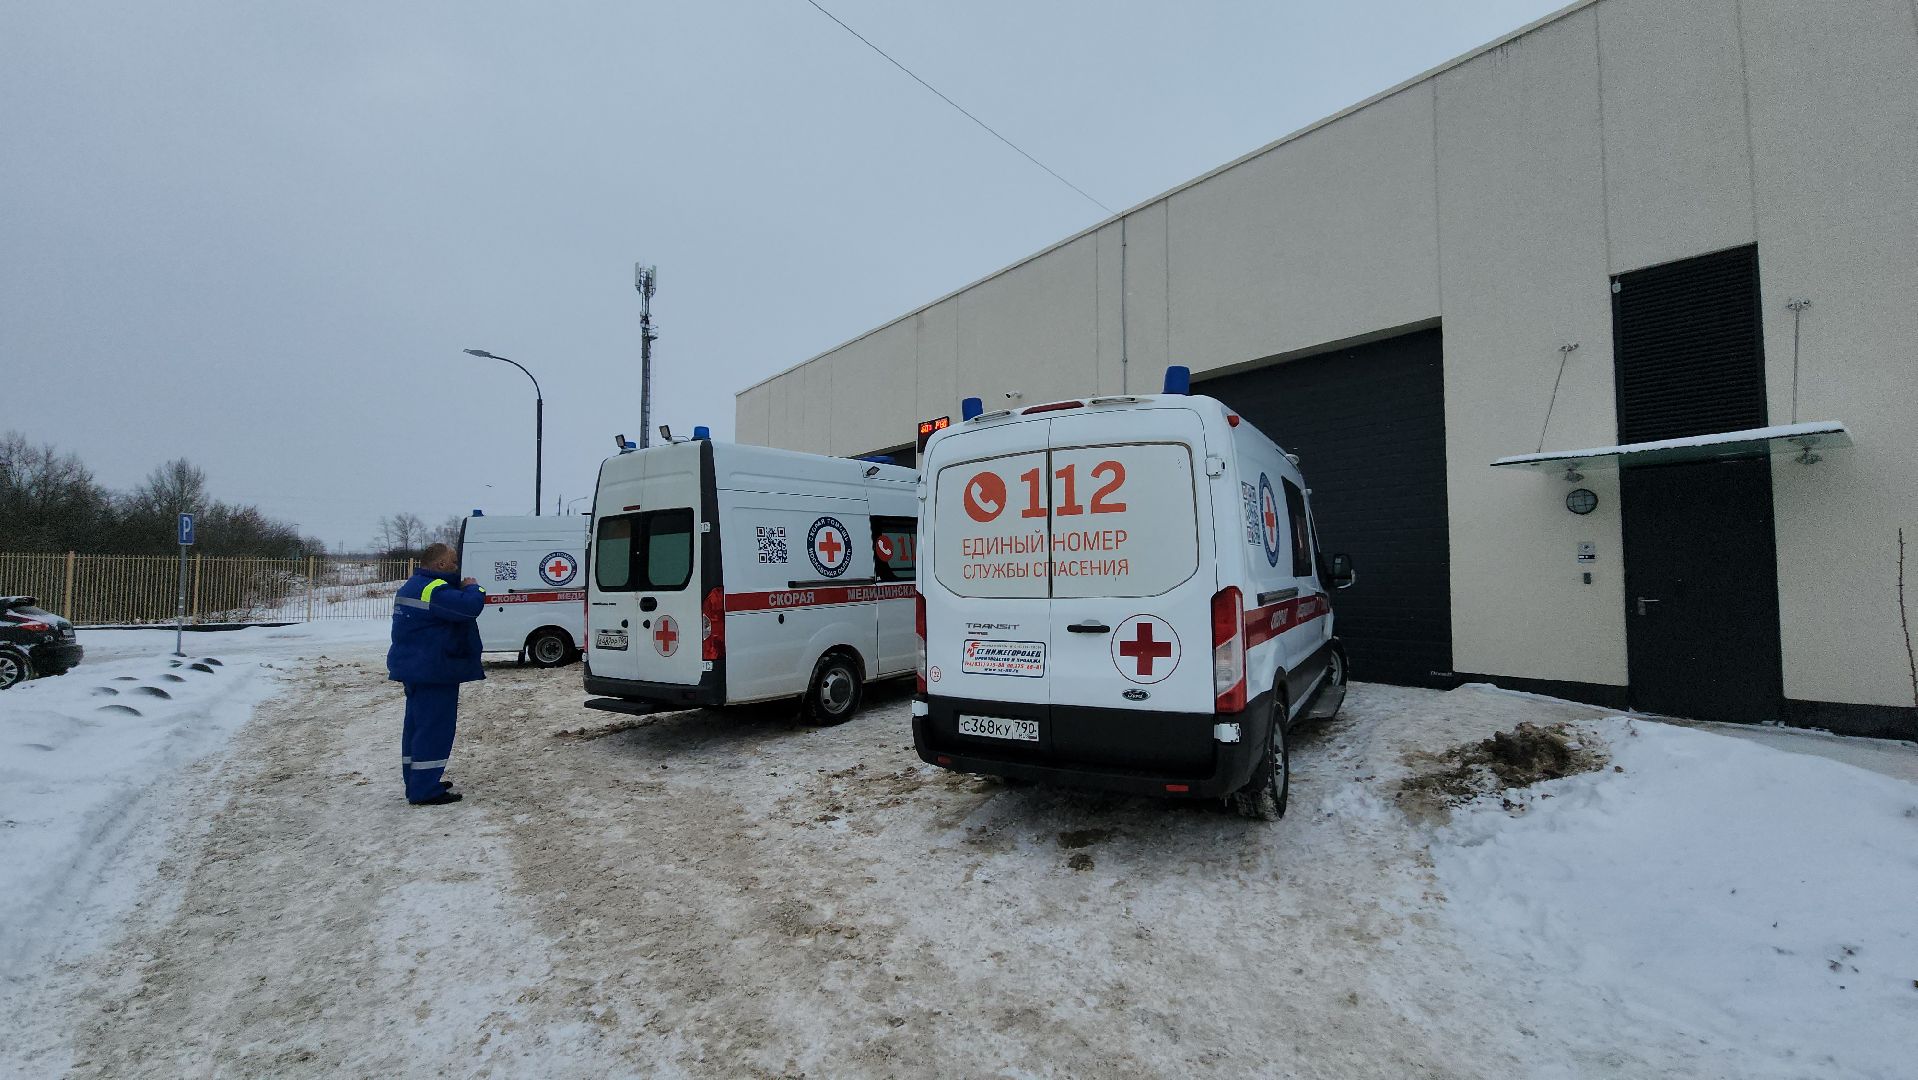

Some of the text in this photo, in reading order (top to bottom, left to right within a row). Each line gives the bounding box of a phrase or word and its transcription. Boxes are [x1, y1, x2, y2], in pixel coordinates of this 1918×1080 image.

[1020, 460, 1127, 518] 112
[183, 516, 191, 540] P
[962, 529, 1128, 559] ЕДИНЫЙ НОМЕР
[963, 559, 1129, 580] СЛУЖБЫ СПАСЕНИЯ
[491, 594, 528, 603] СКОРАЯ
[768, 591, 815, 607] СКОРАЯ
[965, 622, 1020, 631] TRANSIT
[963, 718, 1035, 737] С368КУ 790
